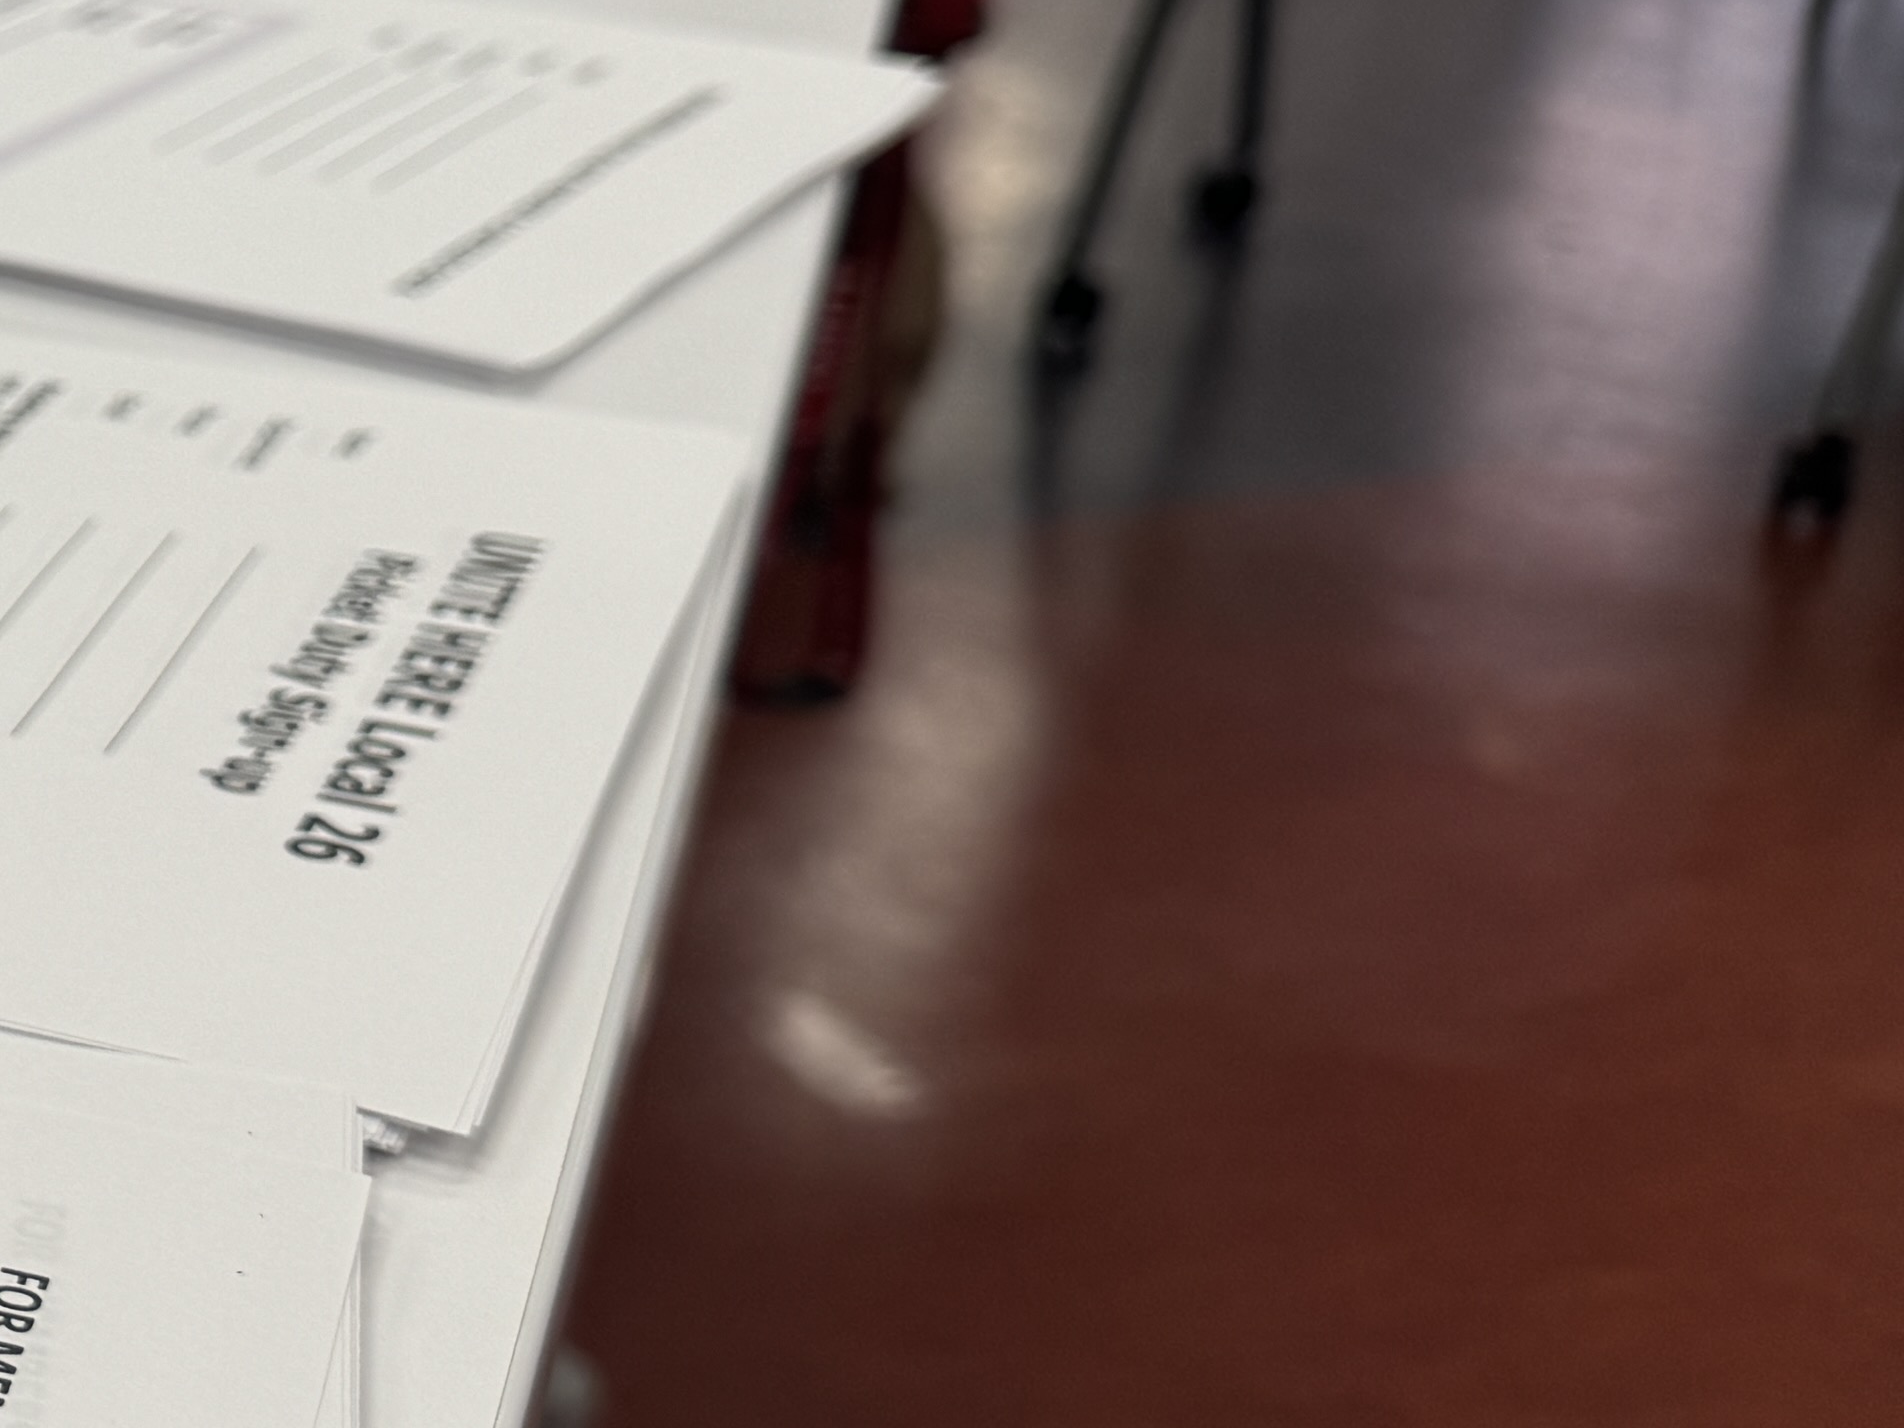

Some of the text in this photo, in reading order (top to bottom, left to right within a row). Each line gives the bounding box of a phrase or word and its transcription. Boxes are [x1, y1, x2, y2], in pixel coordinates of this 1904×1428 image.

[270, 622, 371, 688] Duty
[285, 530, 545, 866] UNITE HERE Local 26
[201, 687, 328, 795] Sign-up
